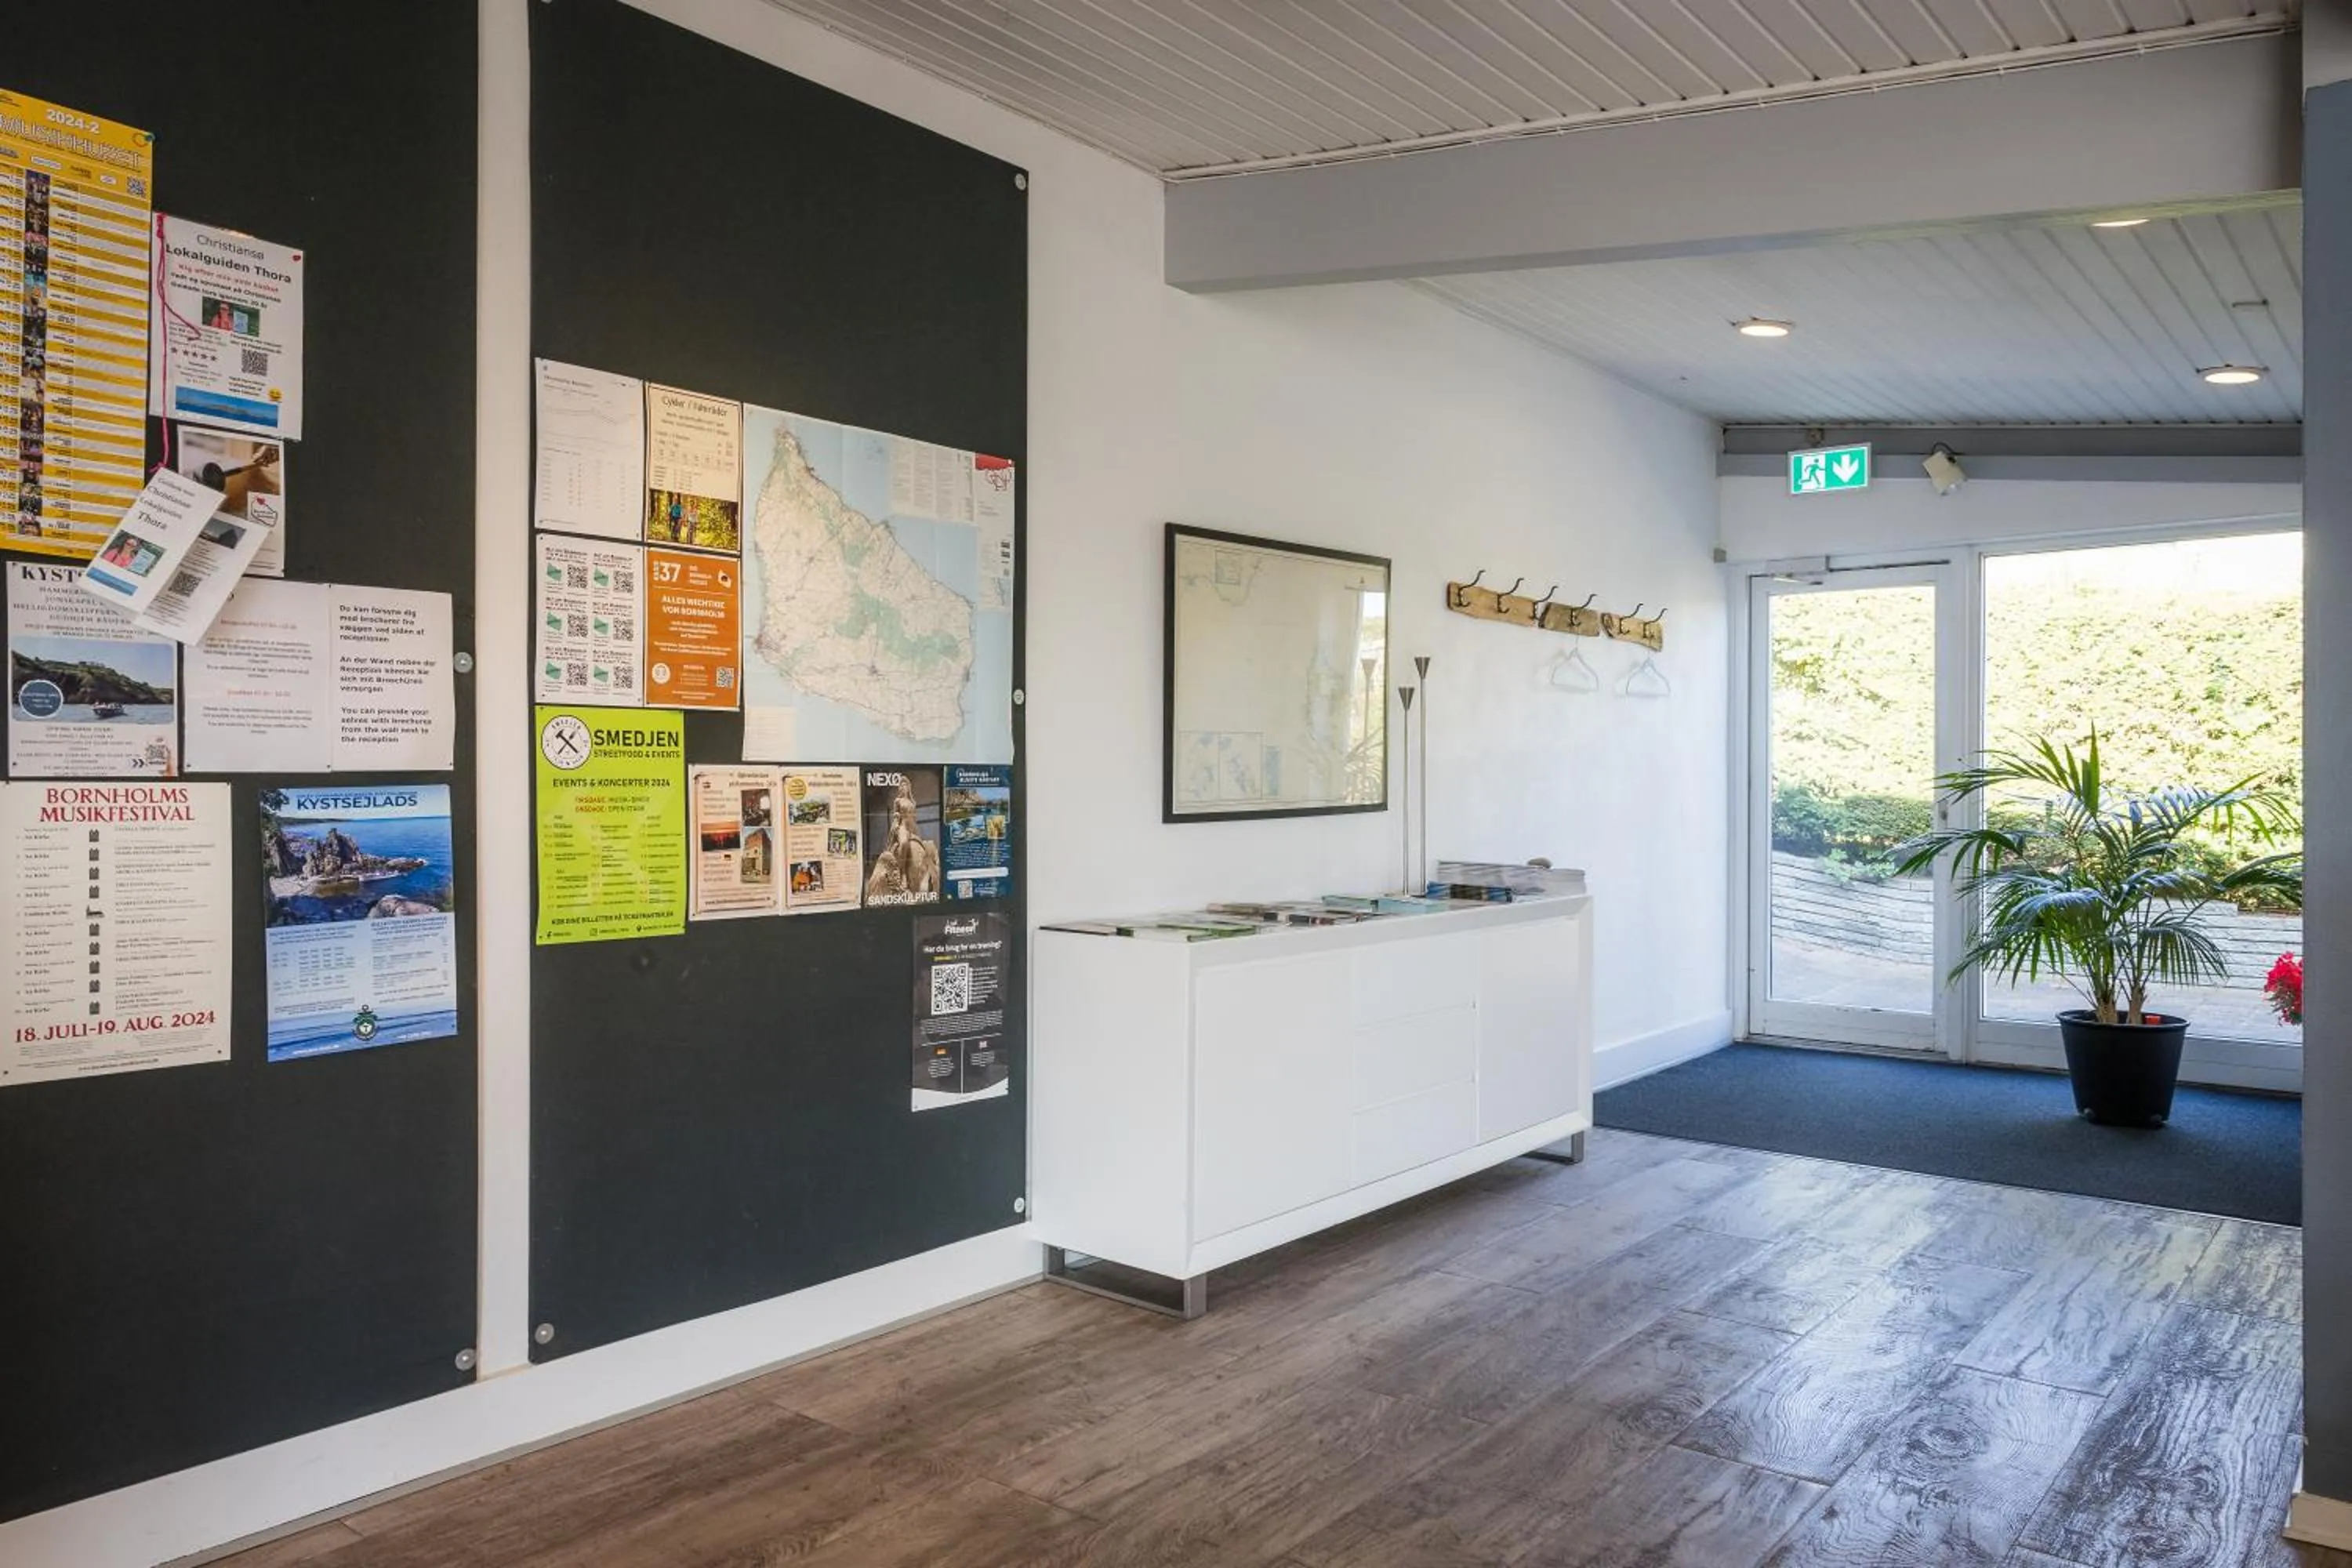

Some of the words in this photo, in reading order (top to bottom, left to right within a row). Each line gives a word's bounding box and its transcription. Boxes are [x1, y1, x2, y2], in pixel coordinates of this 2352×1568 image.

[46, 108, 100, 134] 2024-2
[196, 234, 265, 261] Christiansø
[165, 243, 250, 273] Lokalguiden
[253, 265, 292, 284] Thora
[137, 510, 168, 530] Thora
[659, 561, 681, 583] 37
[404, 609, 416, 618] dig
[377, 707, 408, 716] provide
[593, 729, 679, 748] SMEDJEN
[593, 749, 644, 759] STREETFOOD
[553, 779, 588, 788] EVENTS
[590, 779, 596, 788] &
[598, 778, 650, 788] KONCERTER
[652, 778, 671, 787] 2024
[866, 772, 902, 787] NEXØ
[46, 788, 189, 804] BORNHOLMS
[297, 795, 419, 811] KYSTSEJLADS
[39, 805, 195, 822] MUSIKFESTIVAL
[867, 891, 938, 906] SANDSKULPTUR
[16, 1025, 41, 1044] 18.
[123, 1014, 168, 1033] AUG.
[171, 1010, 216, 1028] 2024
